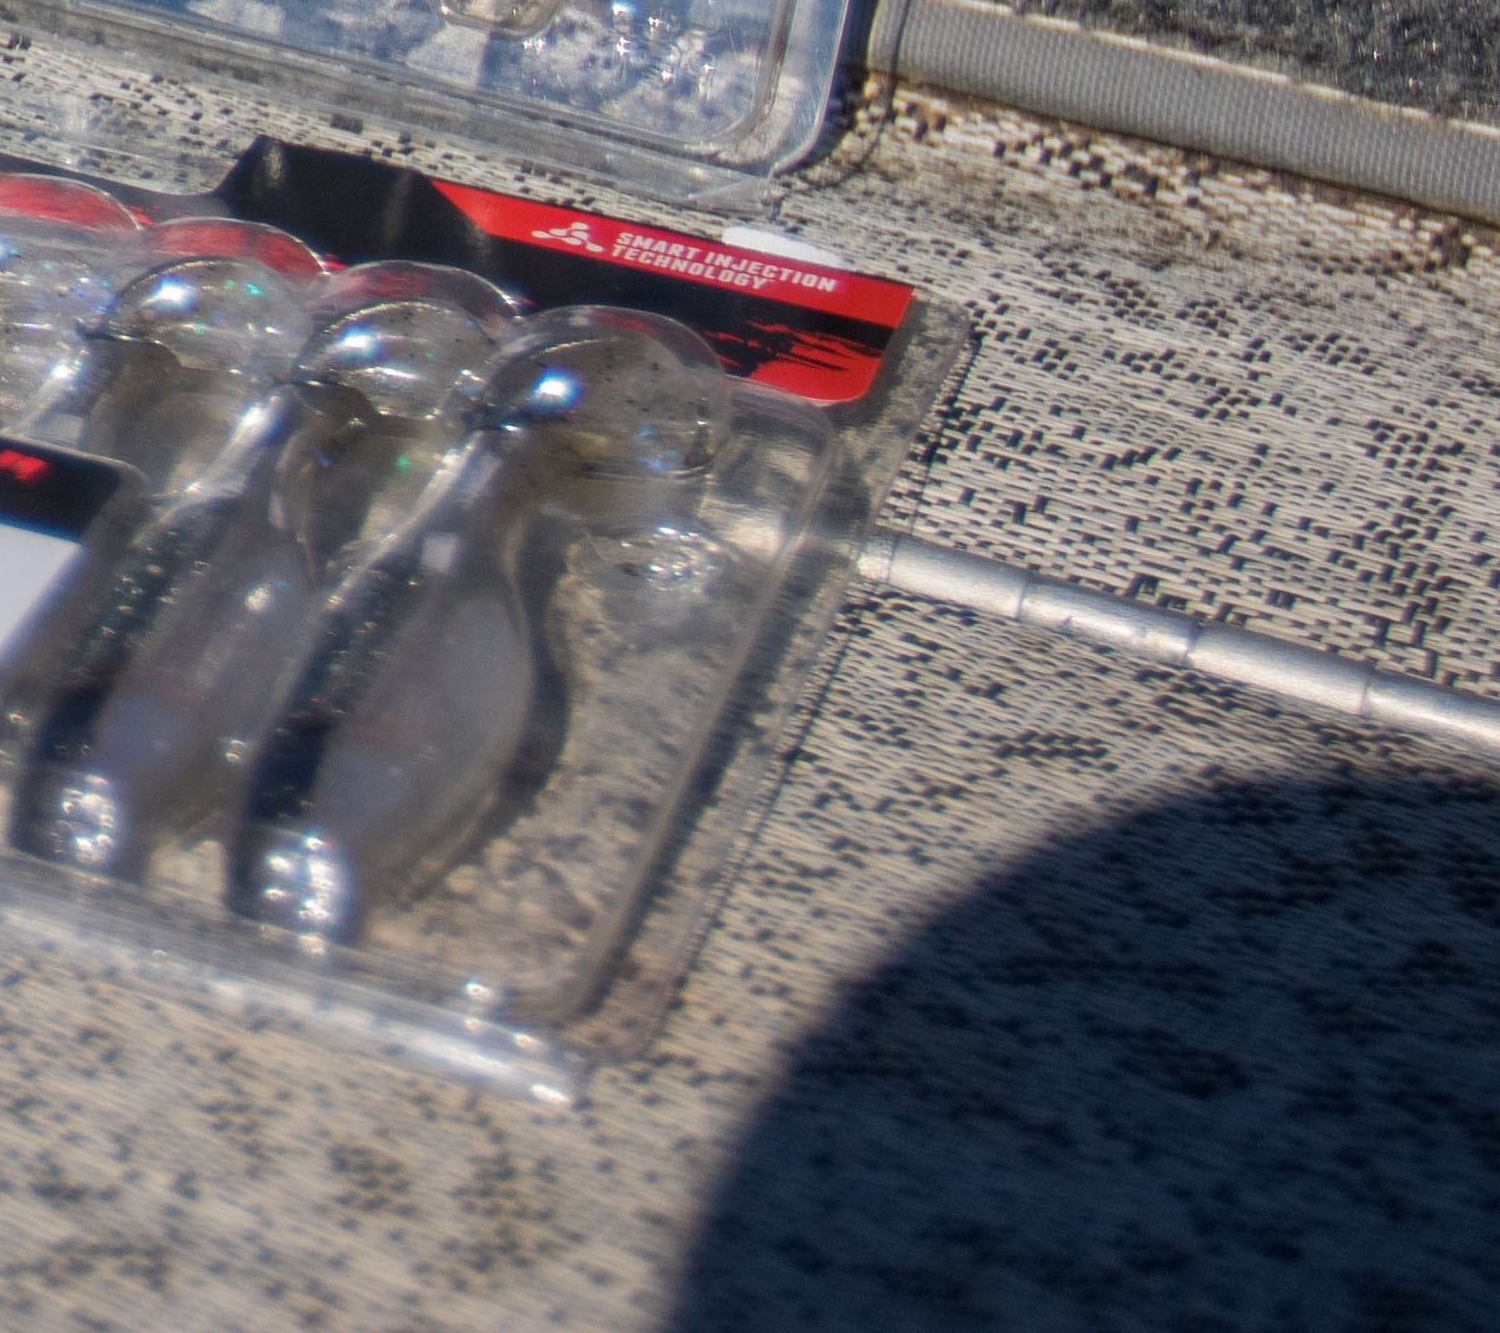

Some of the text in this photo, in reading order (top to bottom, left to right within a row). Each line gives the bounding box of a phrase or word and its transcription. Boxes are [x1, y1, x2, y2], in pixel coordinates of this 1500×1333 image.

[611, 243, 770, 290] TECHNOLOGY
[615, 231, 837, 293] SMART INJECTION
